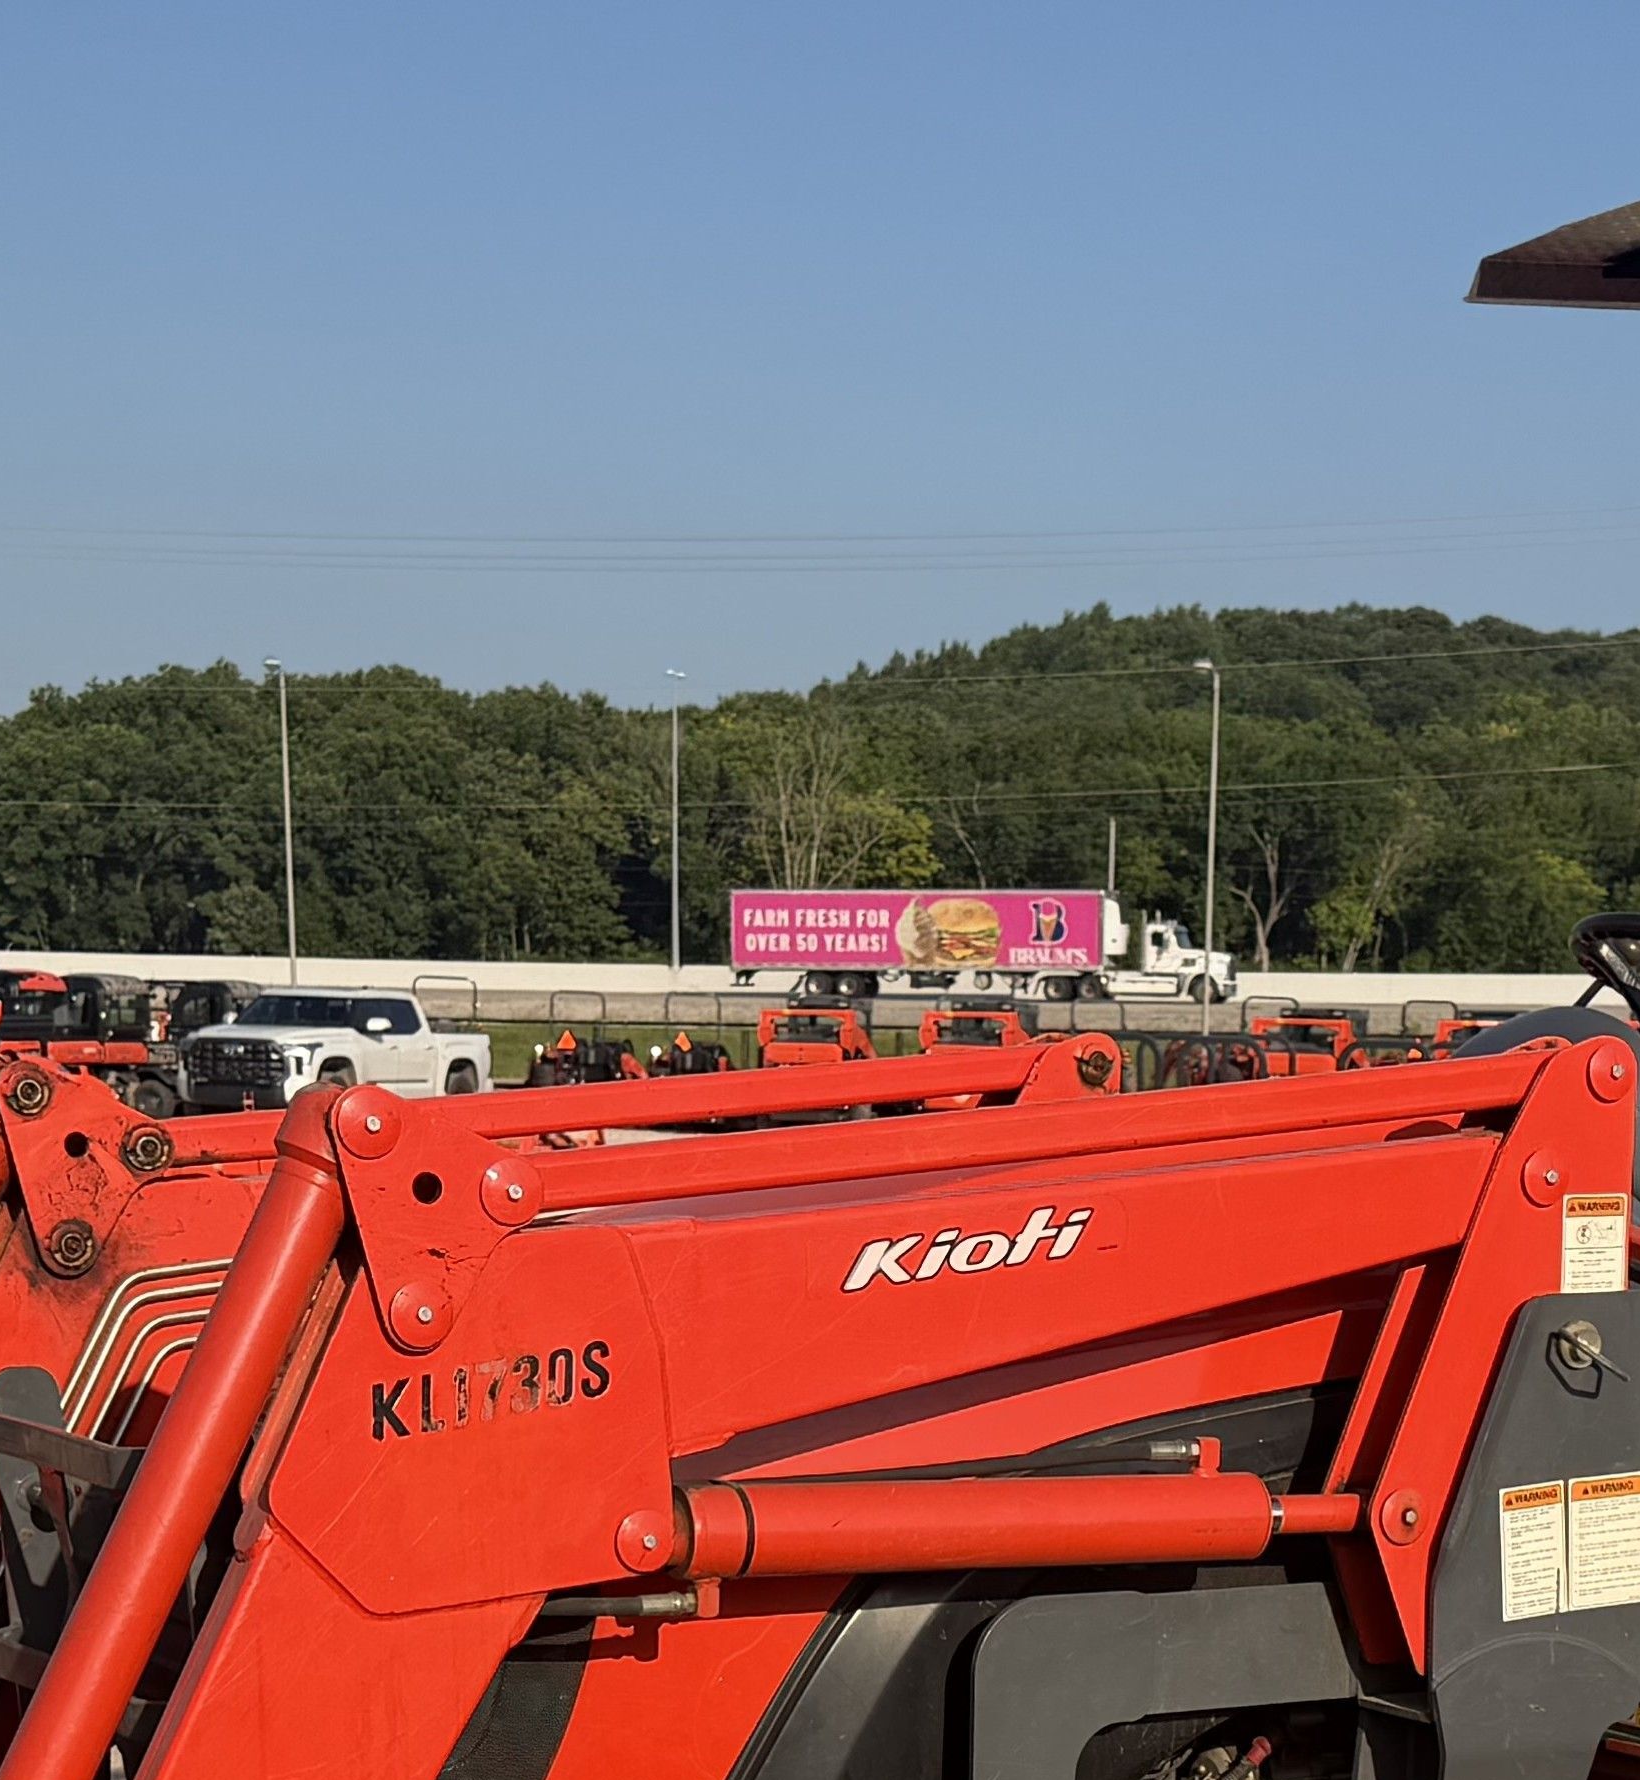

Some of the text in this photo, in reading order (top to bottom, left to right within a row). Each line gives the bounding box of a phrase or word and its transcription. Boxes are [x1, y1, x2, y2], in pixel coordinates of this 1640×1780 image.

[743, 908, 890, 928] FARM FRESH FOR
[745, 933, 888, 952] OVER 50 YEARS!
[1578, 1201, 1621, 1211] WARNING
[371, 1340, 610, 1442] KL1730S
[1591, 1480, 1634, 1494] WARNING
[1514, 1489, 1558, 1503] WARNING
